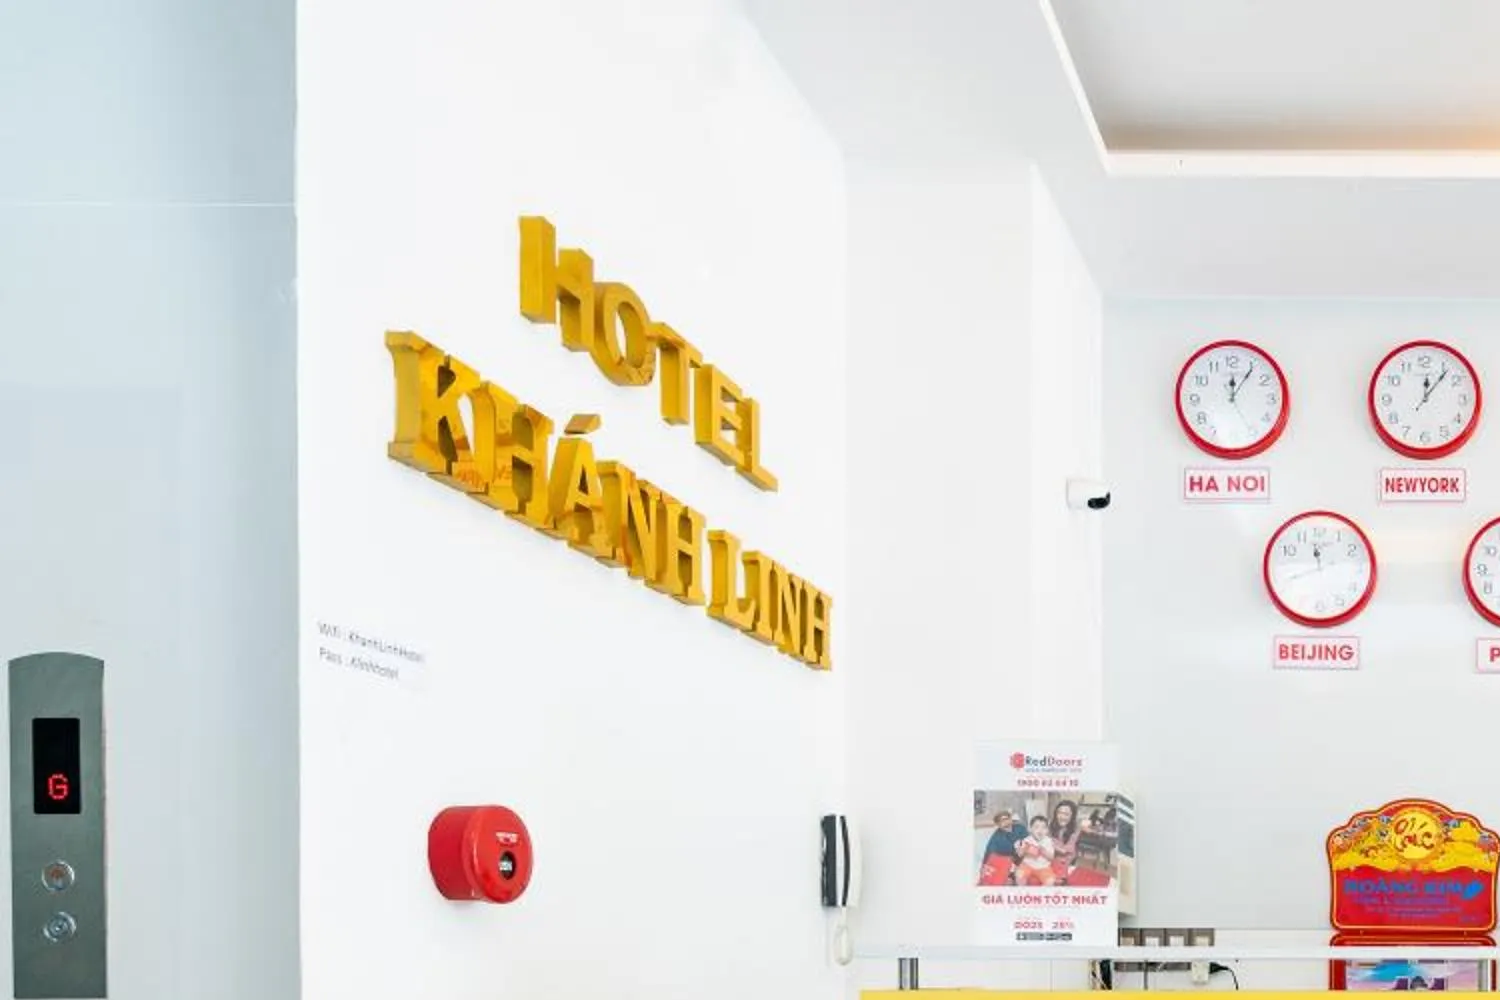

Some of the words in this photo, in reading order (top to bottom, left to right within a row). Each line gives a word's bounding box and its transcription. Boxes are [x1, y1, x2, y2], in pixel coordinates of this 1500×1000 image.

[519, 215, 778, 492] HOTEL
[1209, 360, 1219, 374] 11
[1225, 355, 1239, 369] 12
[1401, 360, 1411, 373] 11
[1417, 355, 1431, 369] 12
[1194, 374, 1209, 387] 10
[1259, 374, 1270, 386] 2
[1386, 374, 1401, 387] 10
[1189, 393, 1201, 407] 9
[1381, 393, 1392, 407] 9
[1401, 425, 1411, 437] 7
[1420, 431, 1431, 443] 6
[1188, 475, 1220, 494] HA
[1227, 475, 1266, 493] NOI
[1384, 476, 1460, 494] NEWYORK
[384, 329, 707, 607] KHÁNH
[707, 529, 832, 671] LINH
[1297, 530, 1307, 544] 11
[1283, 543, 1297, 557] 10
[1347, 543, 1357, 556] 2
[1476, 563, 1487, 576] 9
[1278, 643, 1355, 663] BEIJING
[47, 773, 69, 800] G
